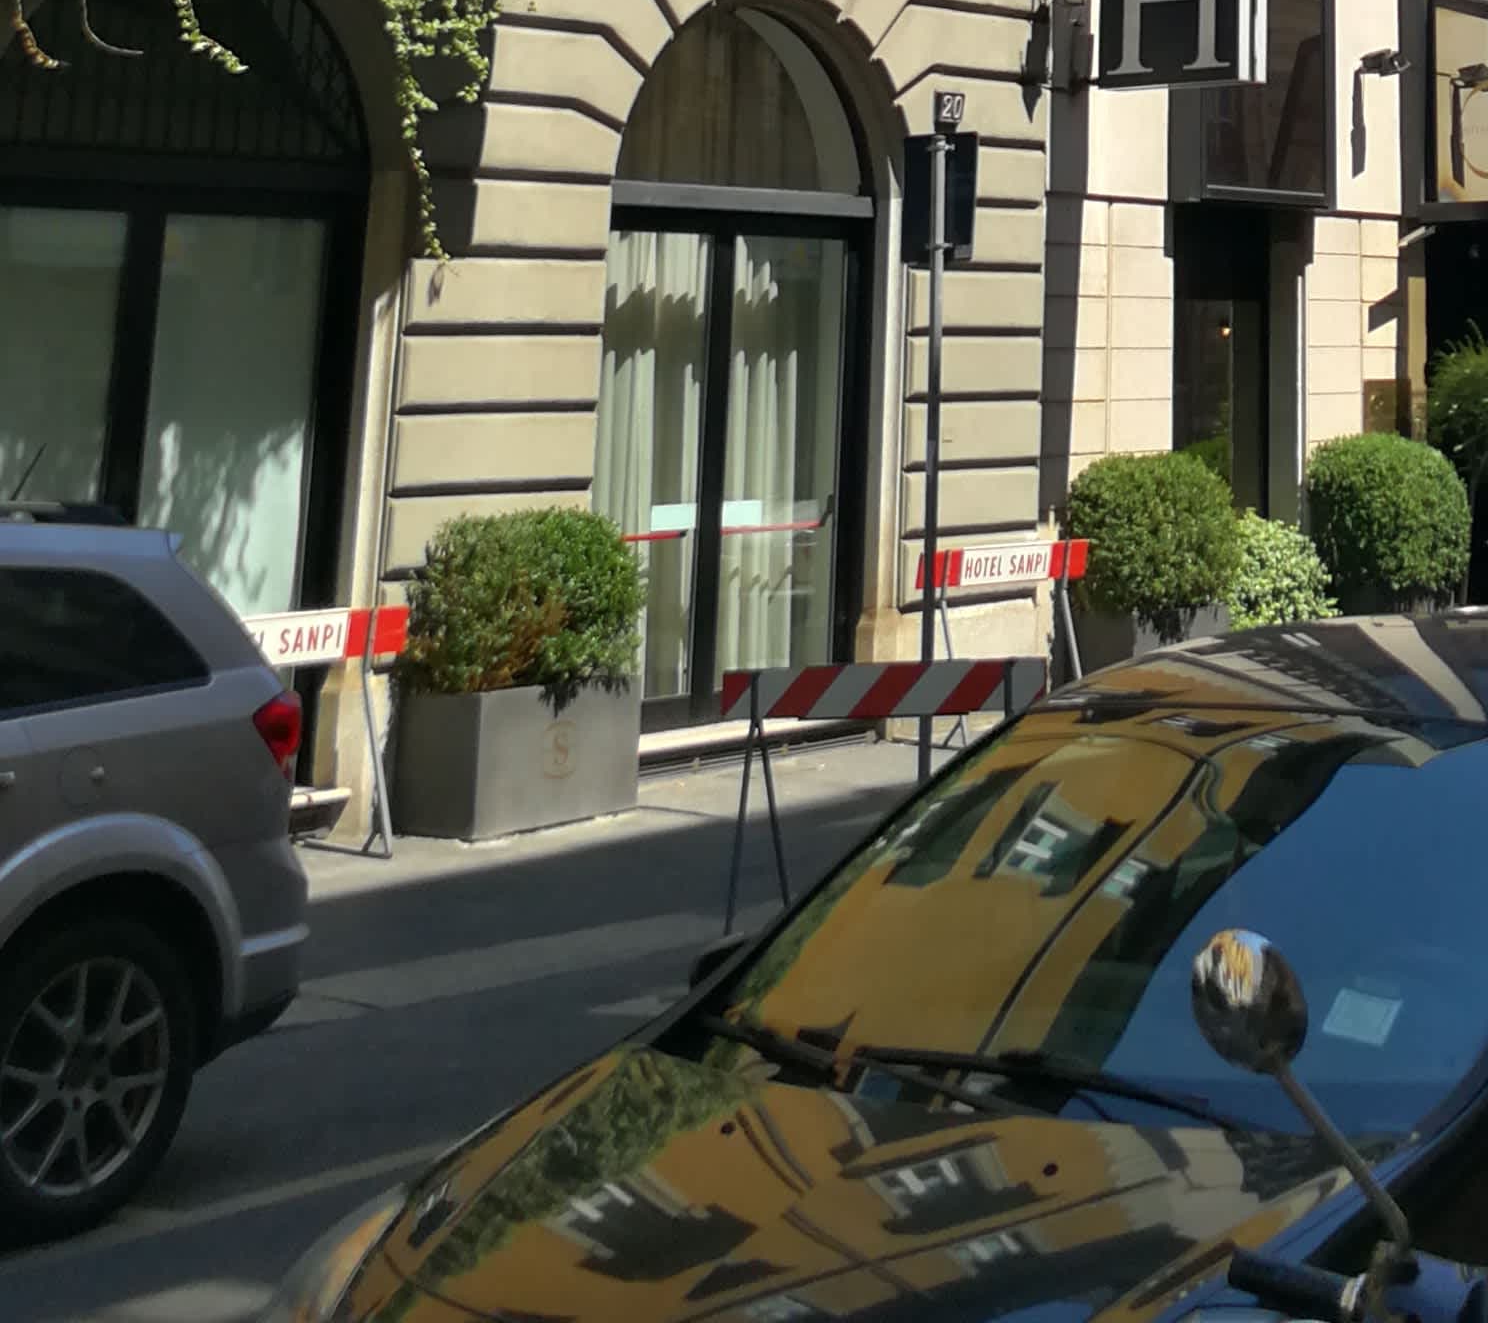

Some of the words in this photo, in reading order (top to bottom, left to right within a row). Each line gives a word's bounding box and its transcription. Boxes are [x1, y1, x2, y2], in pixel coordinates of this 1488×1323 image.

[942, 95, 962, 118] 20
[965, 556, 1002, 580] HOTEL
[1009, 552, 1048, 575] SANPI
[278, 623, 342, 654] SANPI
